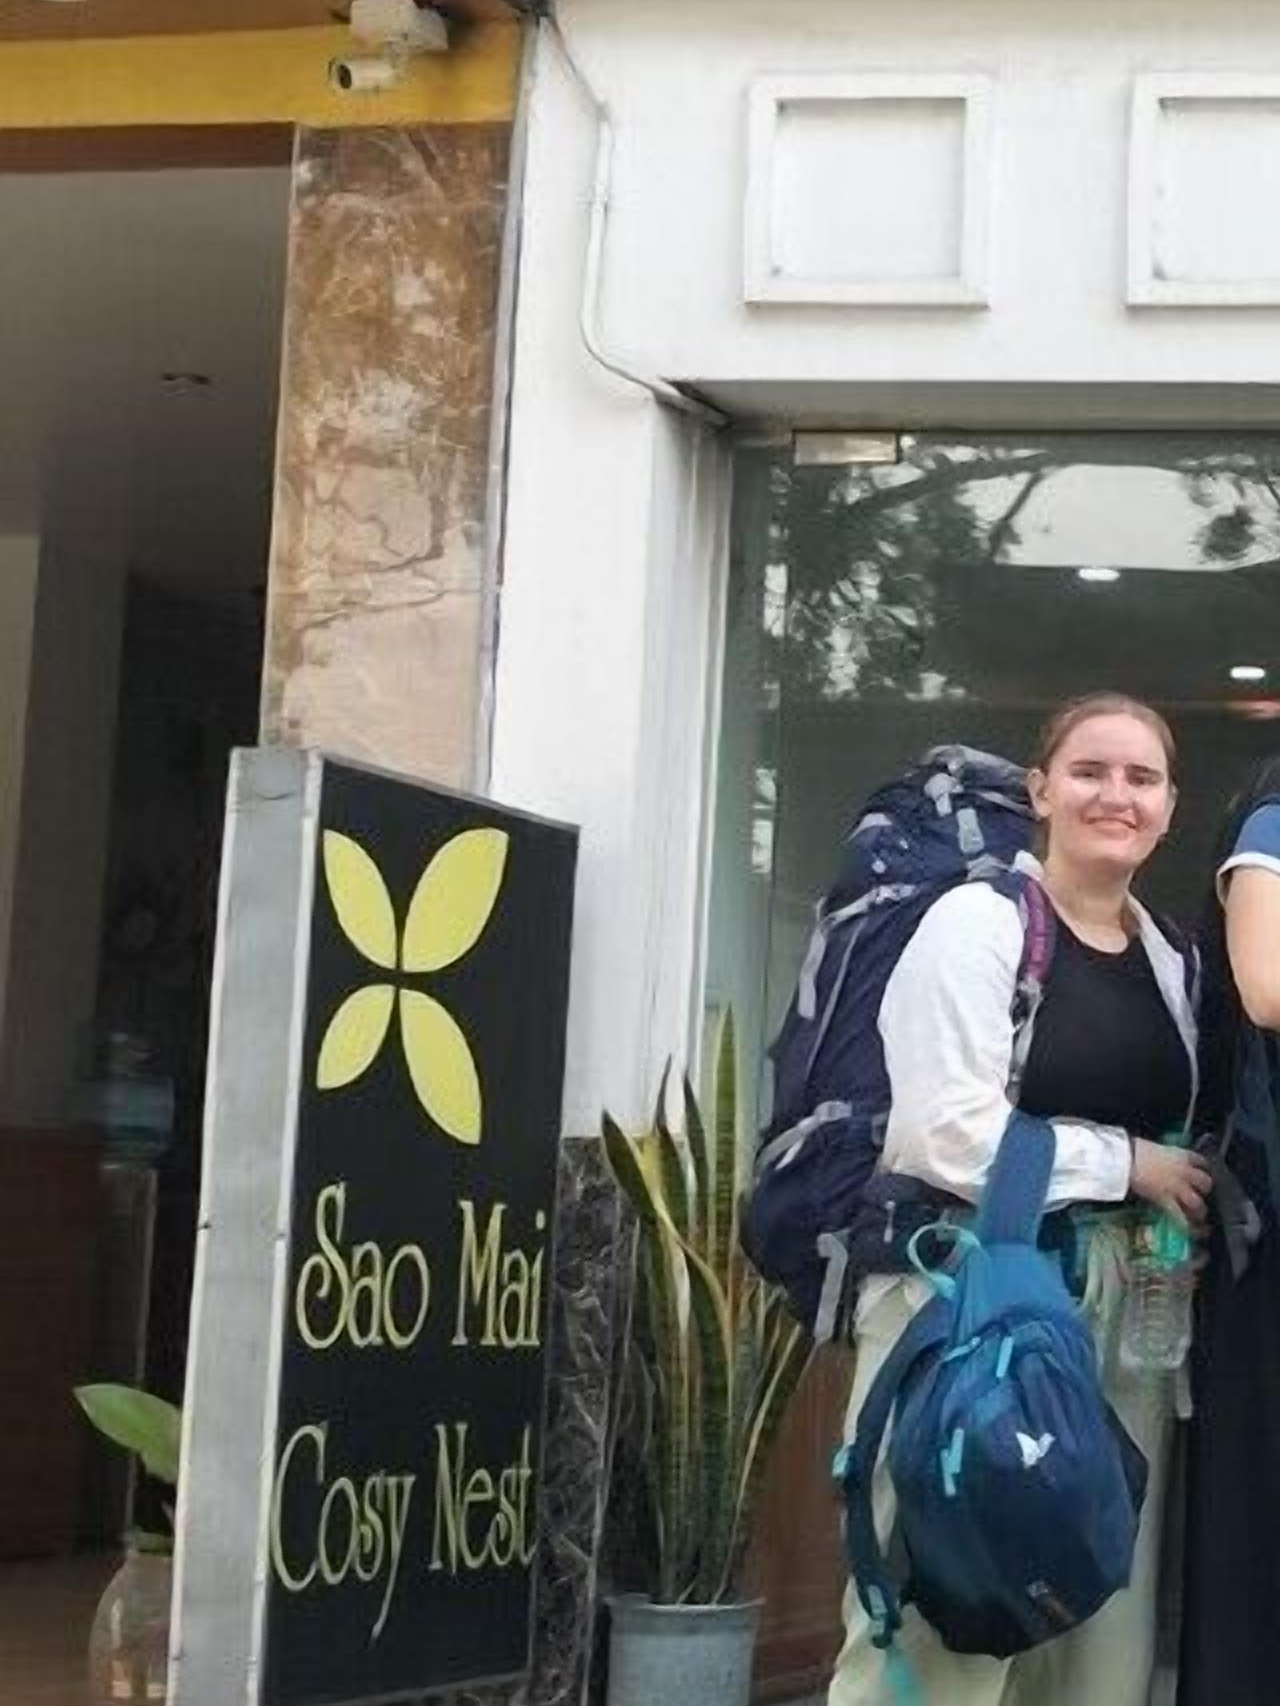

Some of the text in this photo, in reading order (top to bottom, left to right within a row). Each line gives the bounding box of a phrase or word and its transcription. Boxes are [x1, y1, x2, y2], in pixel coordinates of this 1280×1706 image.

[296, 1180, 546, 1350] Sao Mai
[270, 1419, 540, 1649] Cosy Nest
